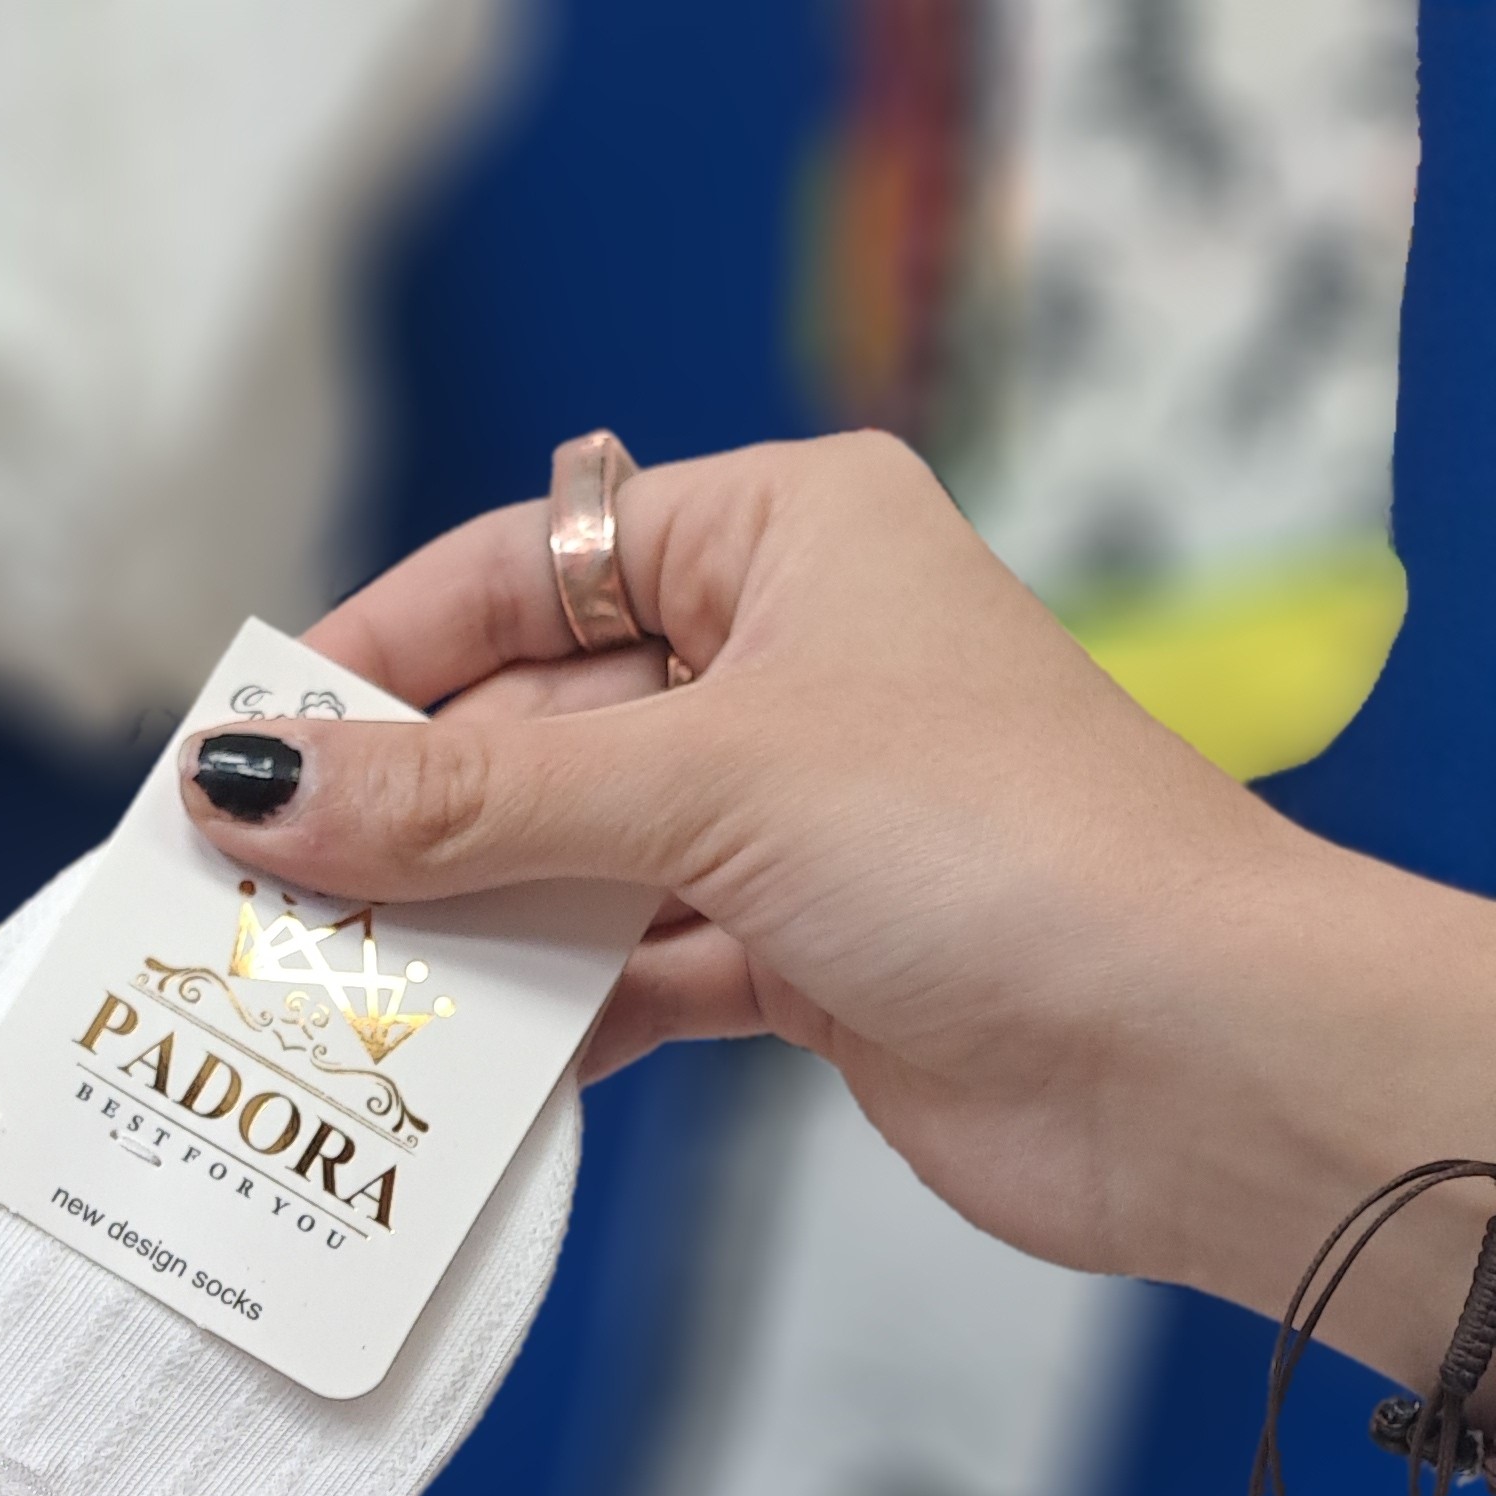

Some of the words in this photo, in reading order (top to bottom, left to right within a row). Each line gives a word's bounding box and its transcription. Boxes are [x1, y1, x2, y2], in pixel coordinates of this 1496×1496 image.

[71, 990, 398, 1234] PADORA
[75, 1081, 171, 1147] BEST
[181, 1146, 255, 1199] FOR
[271, 1196, 347, 1250] YOU
[51, 1187, 106, 1227] new
[107, 1220, 188, 1278] design
[191, 1270, 263, 1321] socks
